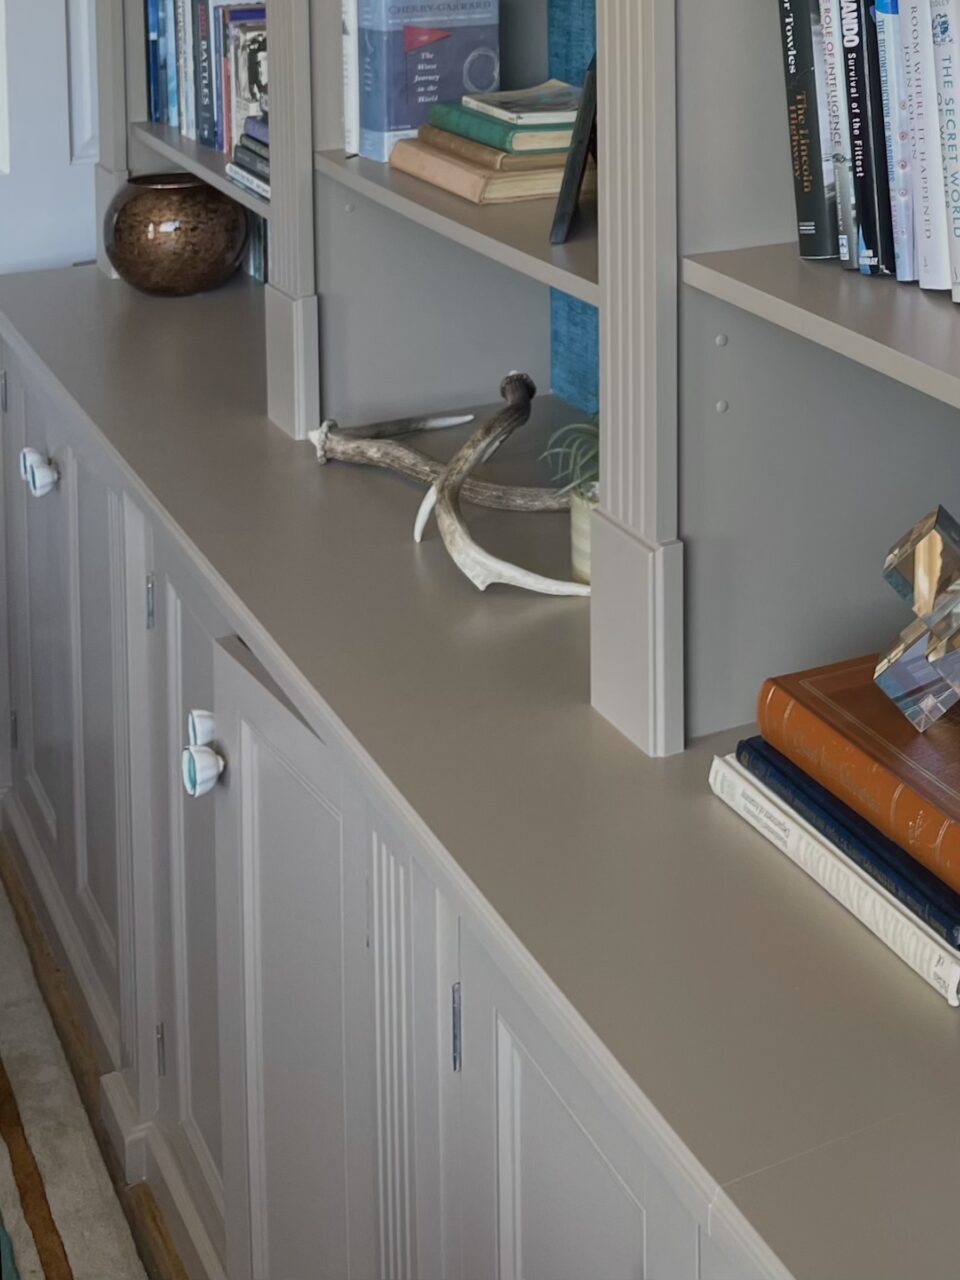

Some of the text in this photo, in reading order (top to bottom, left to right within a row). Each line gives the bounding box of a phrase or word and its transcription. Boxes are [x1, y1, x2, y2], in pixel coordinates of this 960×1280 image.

[784, 12, 798, 75] Towles
[823, 8, 834, 39] ROLE
[910, 6, 921, 55] ROOM
[200, 40, 211, 106] BATTLES
[825, 41, 836, 58] OF
[941, 55, 954, 89] THE
[847, 51, 860, 98] Survival
[914, 60, 925, 120] WHERE
[827, 62, 842, 148] INTELLIGENCE
[850, 102, 862, 114] of
[852, 117, 863, 136] the
[795, 90, 814, 193] The Lincoln
[917, 128, 926, 142] IT
[944, 97, 959, 162] SECRET
[853, 140, 866, 178] Fittest
[919, 150, 932, 240] HAPPENED
